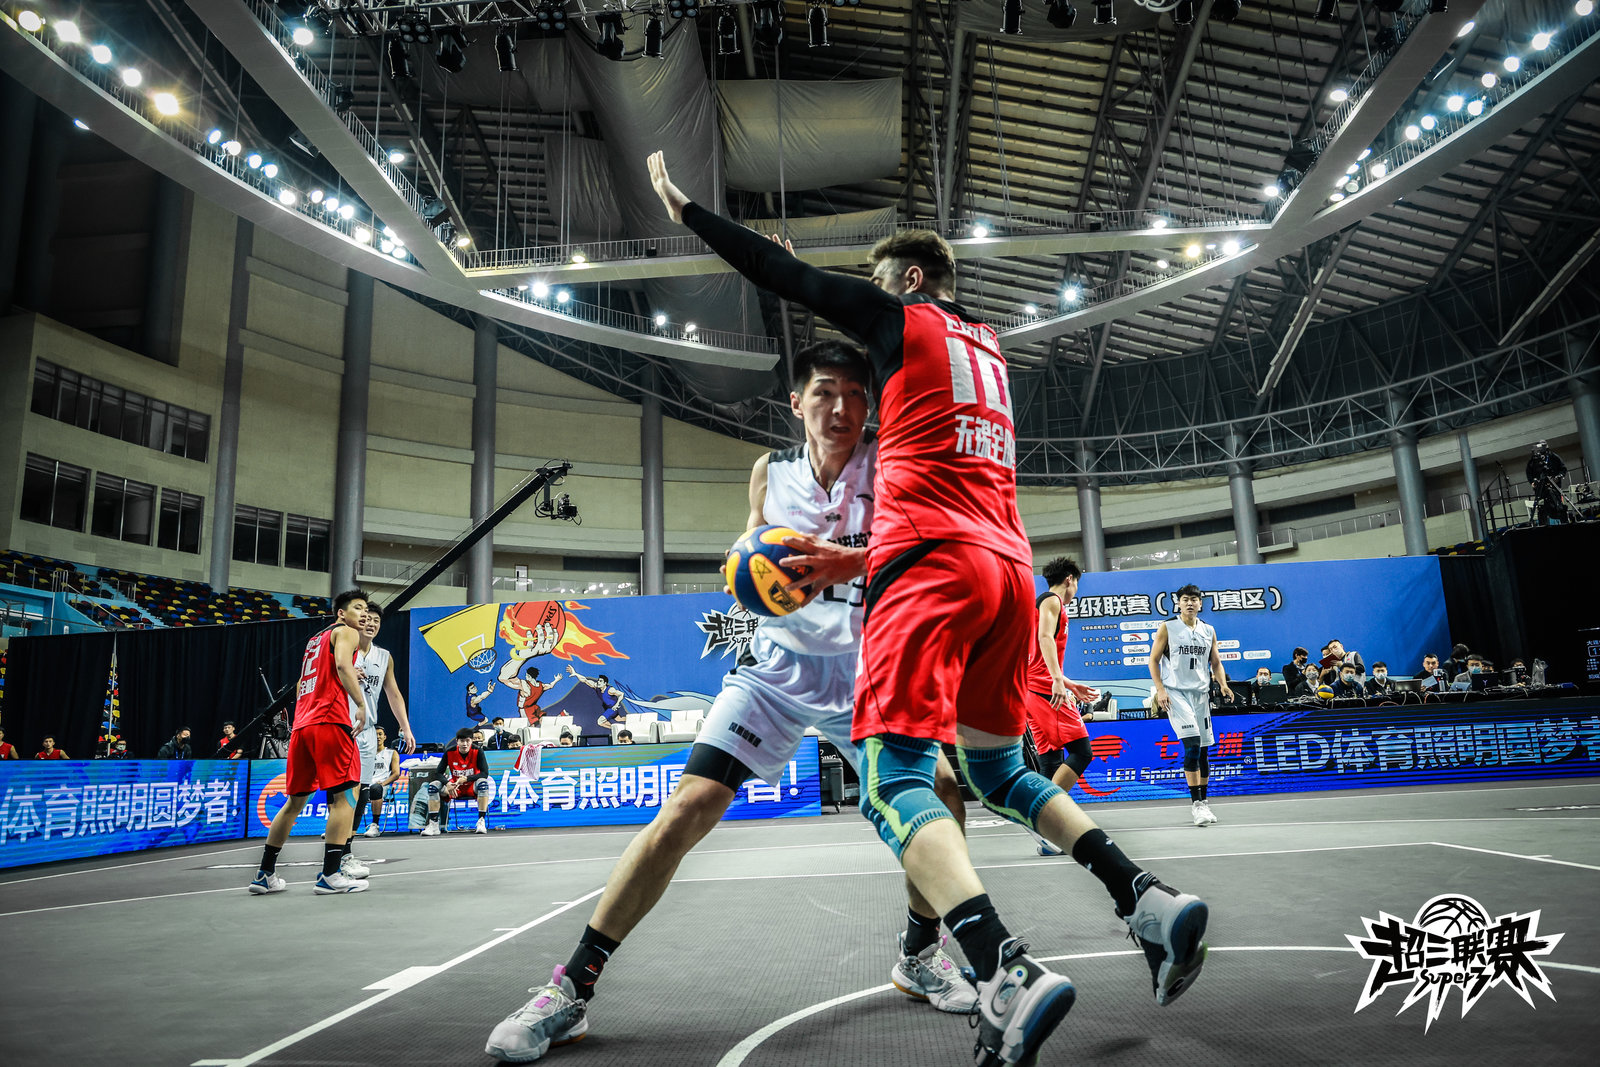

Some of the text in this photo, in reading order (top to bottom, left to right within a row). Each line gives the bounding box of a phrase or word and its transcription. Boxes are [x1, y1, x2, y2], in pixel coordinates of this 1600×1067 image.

[1106, 762, 1245, 785] LED Sport ight
[0, 778, 239, 845] 体育照明圆梦者!
